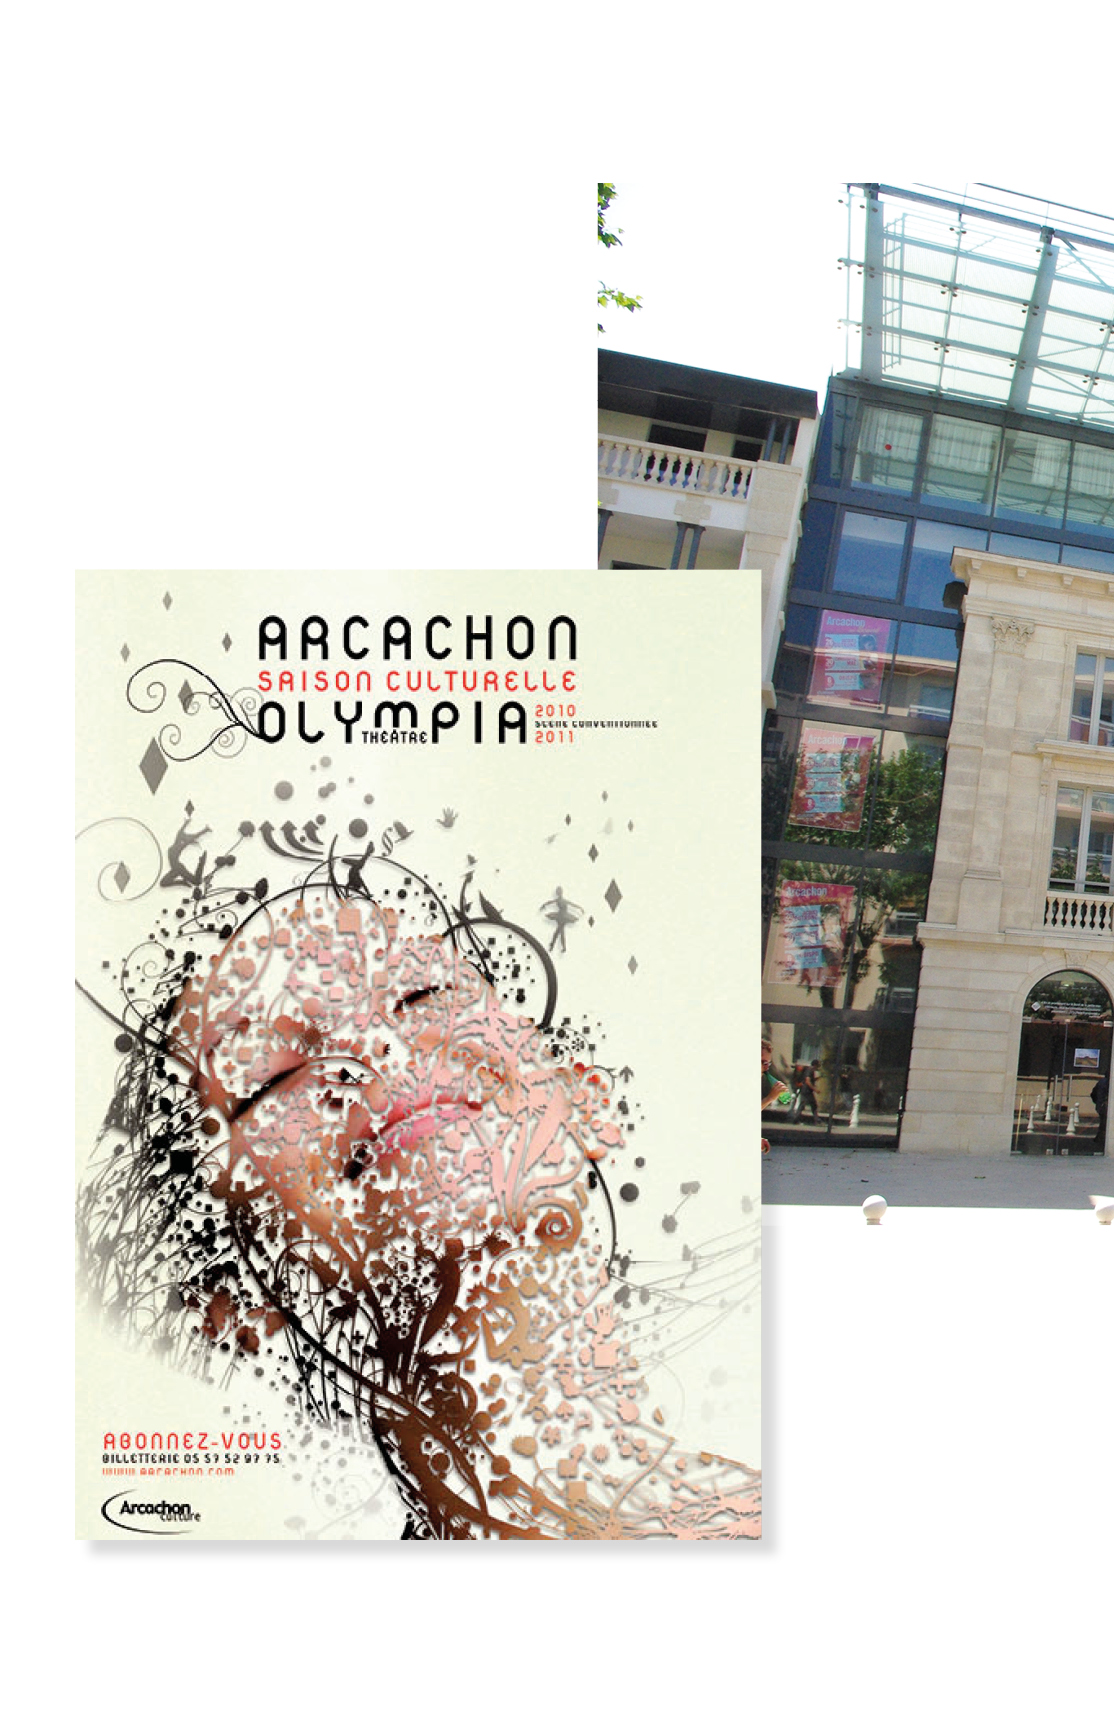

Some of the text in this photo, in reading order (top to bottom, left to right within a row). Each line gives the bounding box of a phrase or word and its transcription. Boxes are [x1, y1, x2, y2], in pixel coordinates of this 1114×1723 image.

[826, 615, 866, 628] Arcachon
[258, 615, 577, 660] ARCACHON
[258, 670, 577, 692] SAISON CULTURELLE
[534, 704, 577, 718] 2010
[257, 701, 527, 744] OLYMPIA
[534, 730, 574, 744] 2011
[103, 1432, 282, 1450] ABONNEZ-VOUS
[102, 1453, 180, 1464] BILLETTERIE
[183, 1453, 200, 1464] 05
[224, 1453, 241, 1464] 52
[265, 1453, 280, 1464] 75
[119, 1500, 192, 1515] Arcachon
